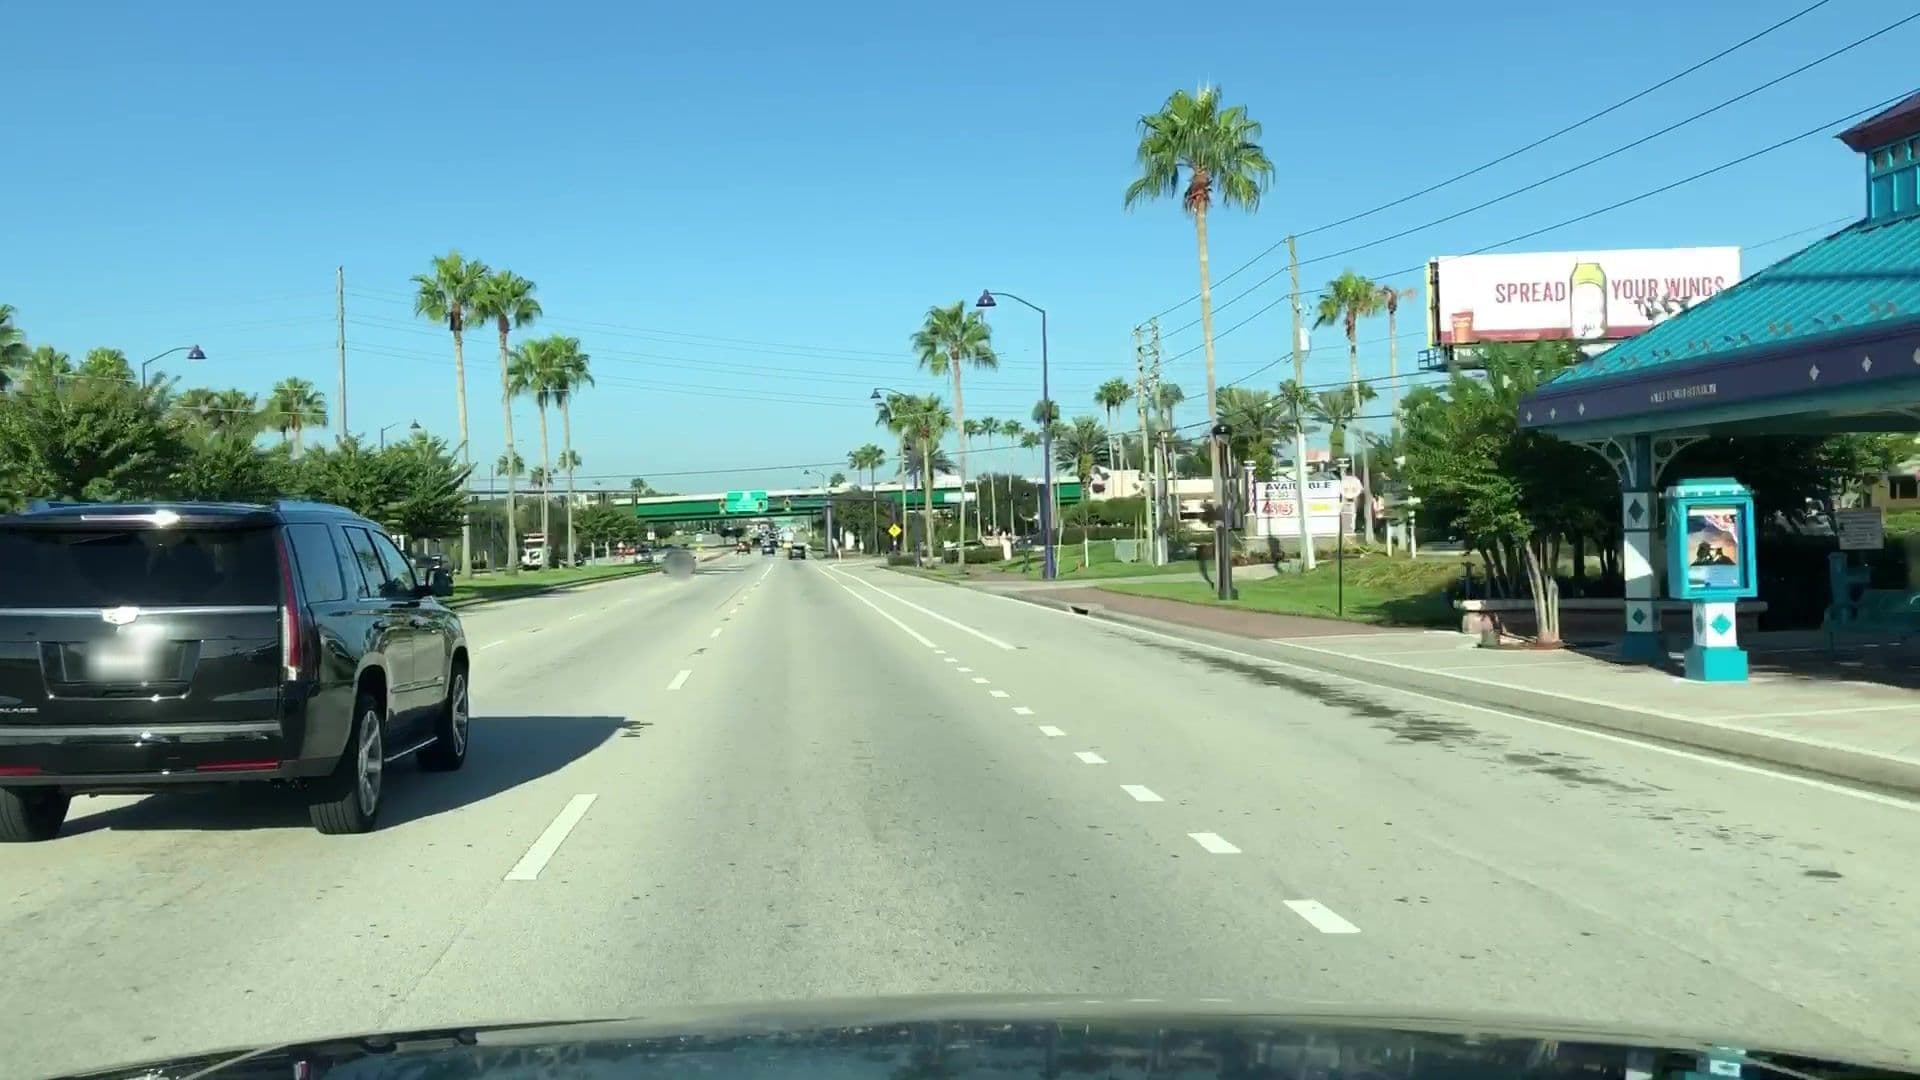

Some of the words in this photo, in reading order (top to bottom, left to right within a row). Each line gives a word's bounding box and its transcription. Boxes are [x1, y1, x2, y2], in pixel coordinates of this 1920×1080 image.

[1495, 281, 1566, 304] SPREAD
[1611, 279, 1658, 301] YOUR
[1664, 276, 1725, 298] WINGS
